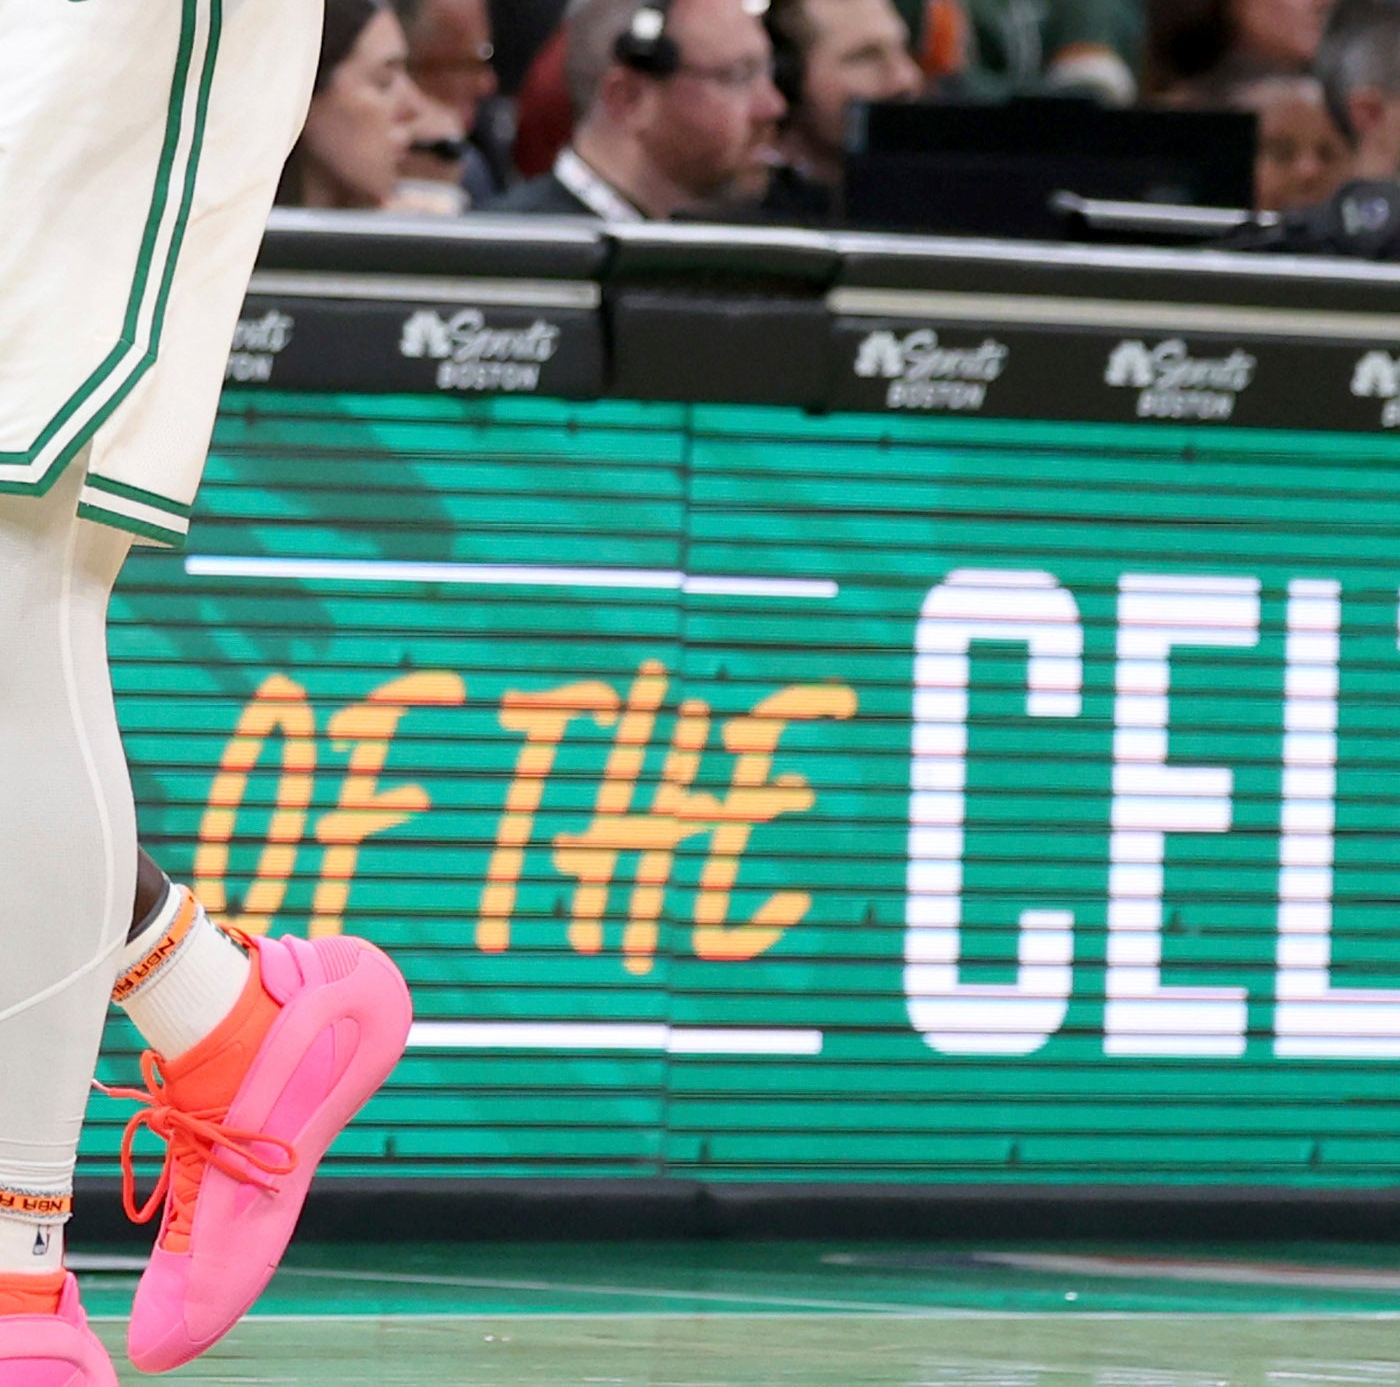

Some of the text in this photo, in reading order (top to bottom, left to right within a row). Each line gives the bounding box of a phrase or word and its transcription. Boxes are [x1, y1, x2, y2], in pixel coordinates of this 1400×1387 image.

[436, 362, 541, 391] BOSTON
[194, 673, 466, 939] OF
[474, 659, 858, 975] THE
[903, 568, 1400, 1060] CEL
[22, 1198, 63, 1212] NBA
